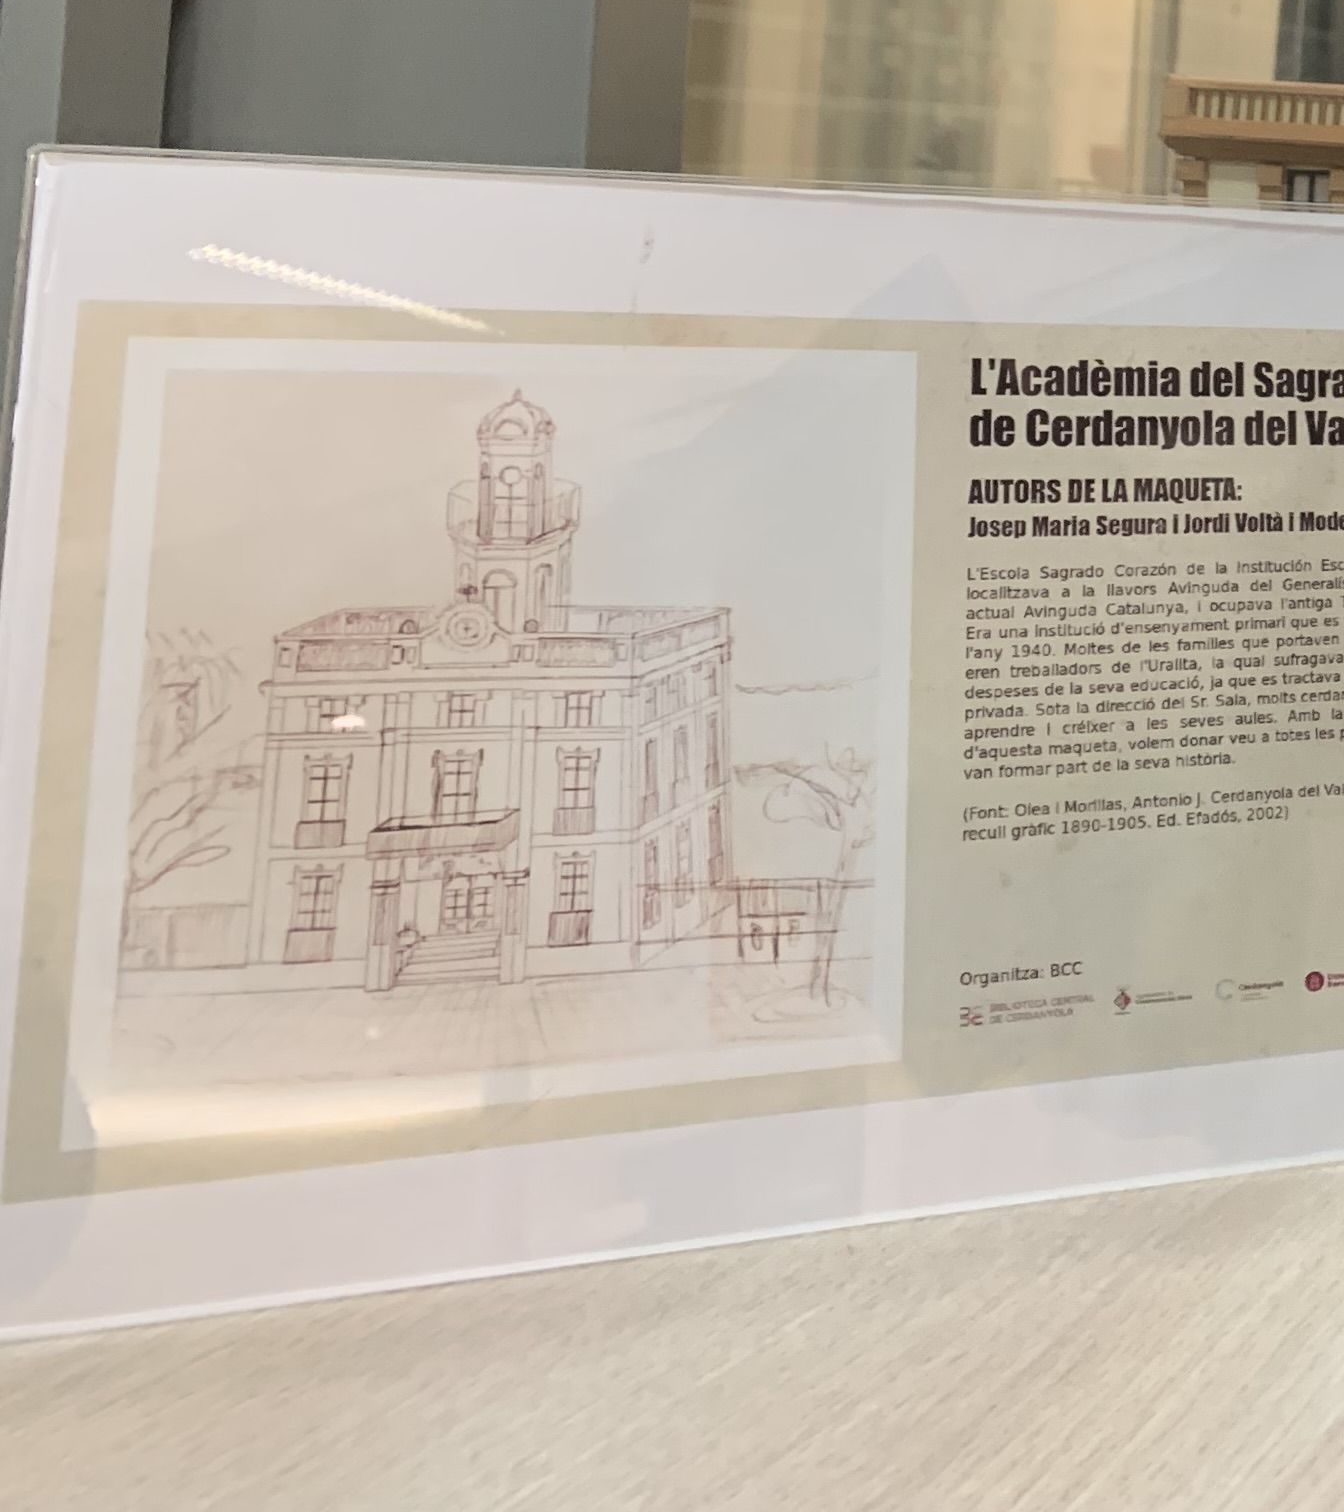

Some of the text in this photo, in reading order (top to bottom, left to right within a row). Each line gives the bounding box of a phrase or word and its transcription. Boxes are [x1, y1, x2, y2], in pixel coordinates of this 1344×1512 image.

[970, 358, 1181, 397] L'Acadèmia
[1190, 362, 1244, 397] del
[969, 409, 1016, 447] de
[1026, 409, 1235, 450] Cerdanyola
[1244, 410, 1296, 446] del
[968, 477, 1243, 504] AUTORS DE LA MAQUETA:
[968, 516, 1026, 538] Josep
[1032, 516, 1090, 537] Maria
[1096, 514, 1167, 537] Segura
[1172, 515, 1179, 533] i
[1183, 513, 1230, 533] Jordi
[1235, 511, 1284, 533] Voltà
[1289, 513, 1297, 531] i
[967, 567, 1030, 581] L'Escola
[1040, 566, 1104, 581] Sagrado
[1115, 563, 1176, 577] Corazón
[1187, 563, 1205, 575] de
[1216, 562, 1227, 574] la
[1237, 559, 1312, 573] Institución
[967, 586, 1049, 600] localitzava
[1061, 588, 1071, 598] a
[1083, 584, 1094, 597] la
[1107, 583, 1157, 596] llavors
[1168, 579, 1239, 596] Avinguda
[1250, 579, 1272, 592] del
[966, 606, 1014, 620] actual
[1024, 604, 1096, 621] Avinguda
[1106, 602, 1188, 616] Catalunya,
[1210, 600, 1272, 614] ocupava
[1281, 597, 1332, 612] l'antiga
[966, 626, 991, 640] Era
[999, 627, 1028, 638] una
[1111, 619, 1228, 636] d'ensenyament
[1235, 616, 1285, 633] primari
[1291, 617, 1318, 632] que
[1323, 616, 1339, 627] es
[966, 646, 1002, 662] l'any
[1012, 644, 1055, 658] 1940.
[1064, 643, 1114, 656] Moltes
[1122, 642, 1141, 653] de
[1150, 640, 1169, 652] les
[1242, 638, 1269, 652] que
[1277, 633, 1339, 650] portaven
[966, 667, 999, 679] eren
[1010, 662, 1101, 679] treballadors
[1112, 662, 1130, 674] de
[1212, 657, 1224, 669] la
[1234, 656, 1264, 672] qual
[1274, 651, 1344, 670] sufragava
[964, 768, 993, 779] van
[999, 763, 1052, 778] formar
[1056, 761, 1087, 778] part
[1092, 760, 1111, 772] de
[1117, 758, 1129, 770] la
[1135, 756, 1170, 769] seva
[1015, 802, 1049, 817] Olea
[1133, 792, 1192, 809] Antonio
[1211, 783, 1293, 804] Cerdanyola
[1298, 784, 1320, 798] del
[963, 826, 1006, 841] recull
[1061, 815, 1152, 834] 1890-1905.
[1157, 813, 1180, 828] Ed.
[1247, 806, 1289, 821] 2002)
[960, 961, 1084, 988] Organitza: BCC
